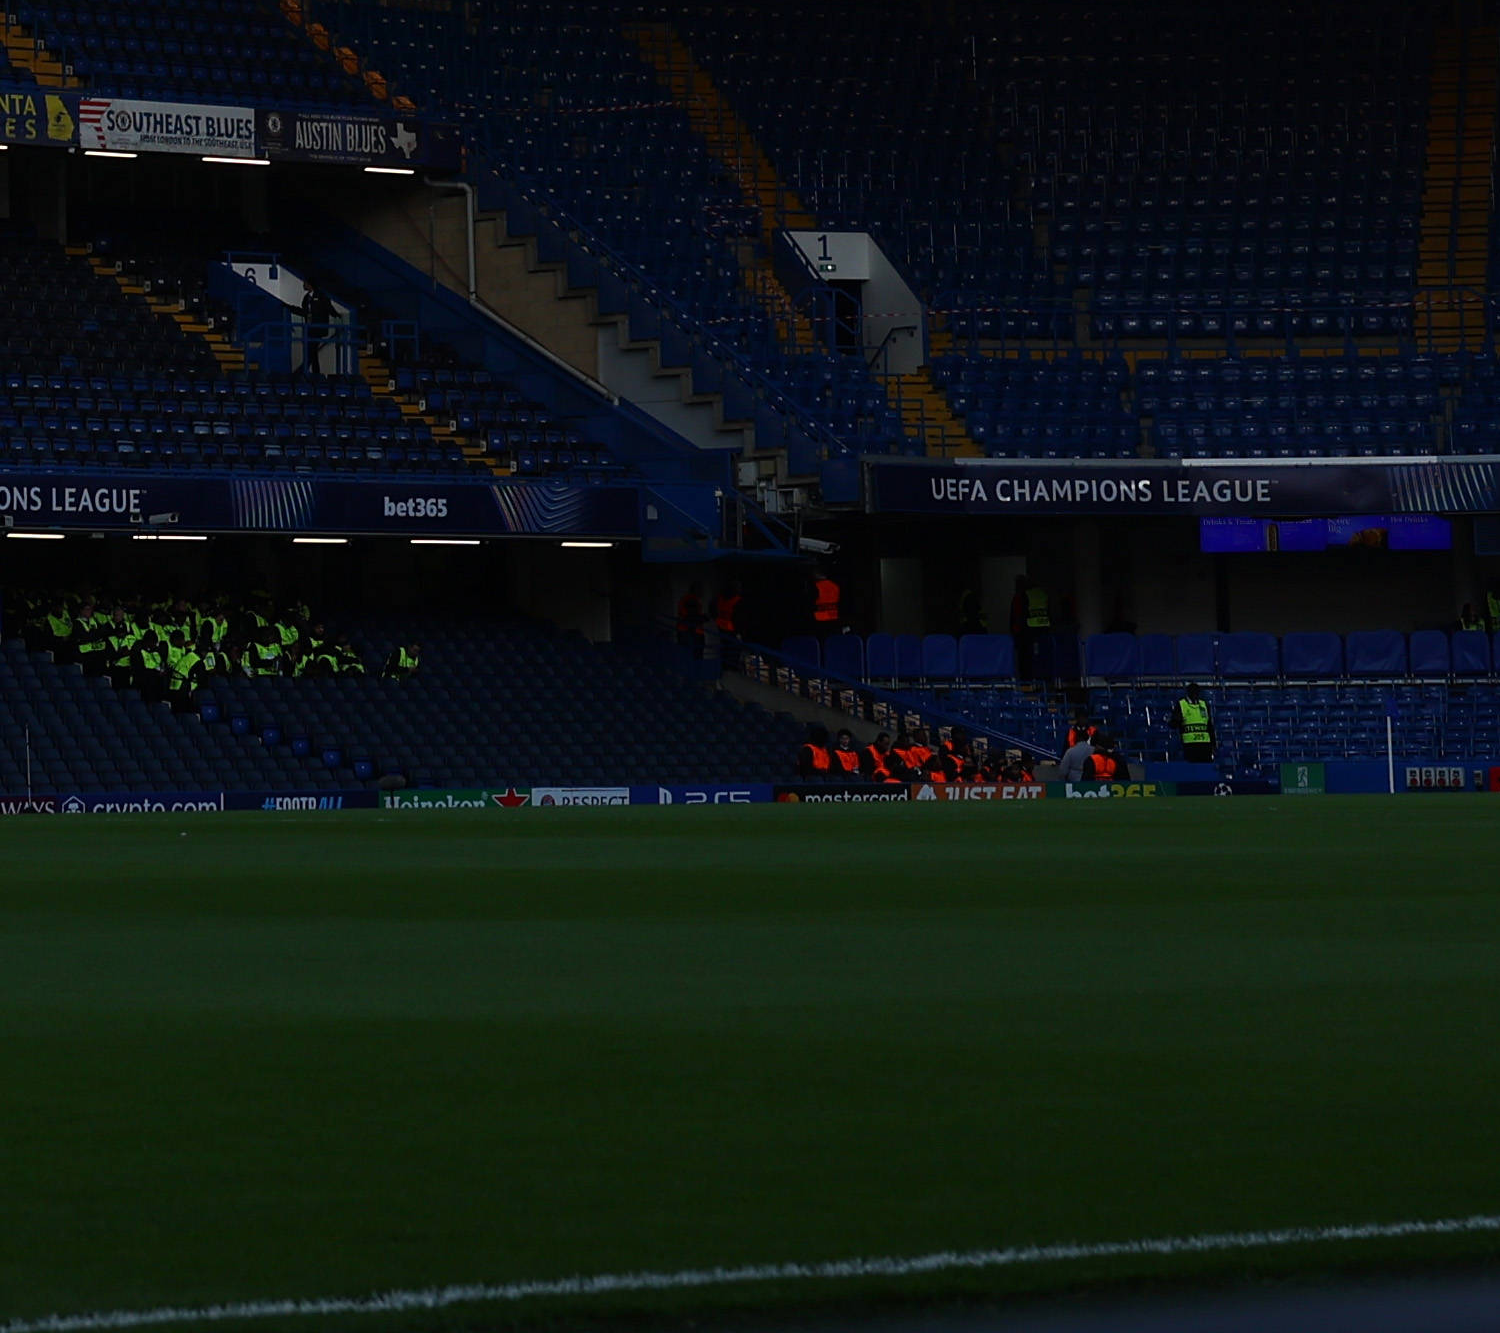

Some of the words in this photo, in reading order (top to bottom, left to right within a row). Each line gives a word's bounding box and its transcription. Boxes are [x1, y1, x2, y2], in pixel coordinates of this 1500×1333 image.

[206, 117, 252, 139] BLUES
[295, 121, 342, 150] AUSTIN
[347, 124, 386, 154] BLUES
[818, 235, 832, 260] 1
[931, 478, 989, 502] UEFA
[995, 479, 1152, 502] CHAMPIONS
[384, 496, 448, 517] bet365
[805, 786, 908, 803] mastercard
[945, 785, 997, 801] JUST
[1002, 785, 1042, 800] EAT
[92, 798, 217, 813] cryptocom
